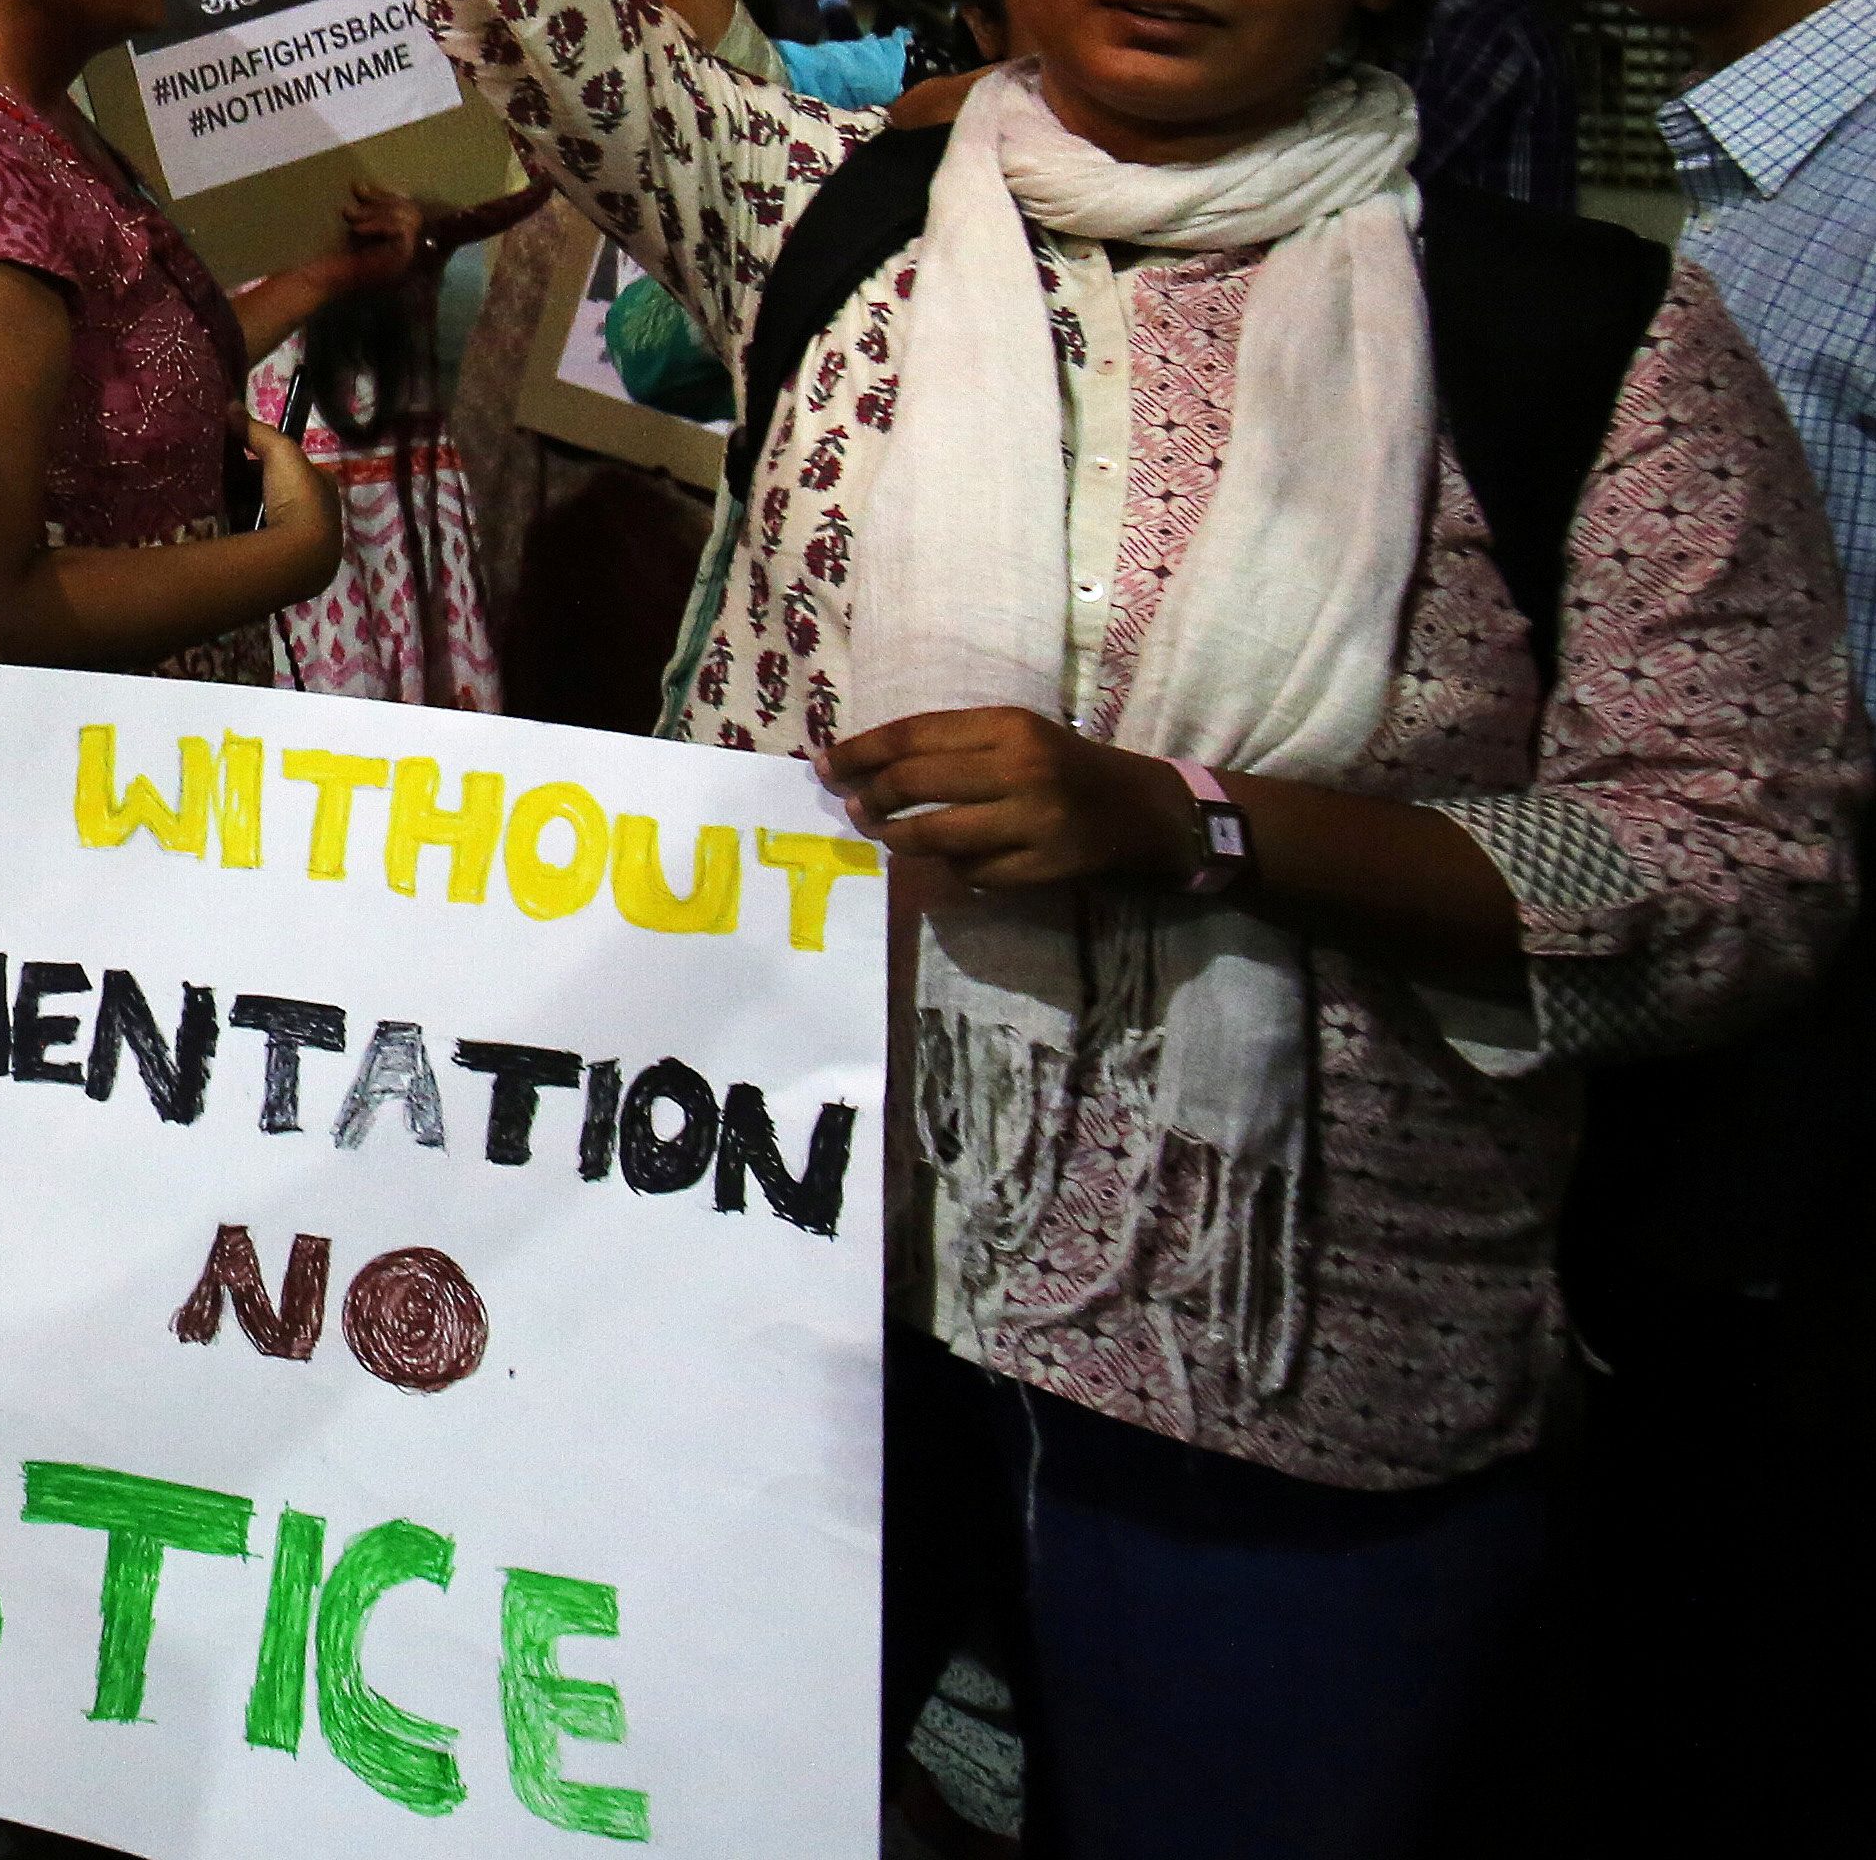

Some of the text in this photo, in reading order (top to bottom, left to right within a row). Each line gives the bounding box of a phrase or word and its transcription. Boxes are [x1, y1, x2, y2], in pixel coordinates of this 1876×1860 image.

[188, 43, 414, 138] #NOTINMYNAME
[73, 724, 885, 951] WITHOUT
[171, 1225, 490, 1393] NO
